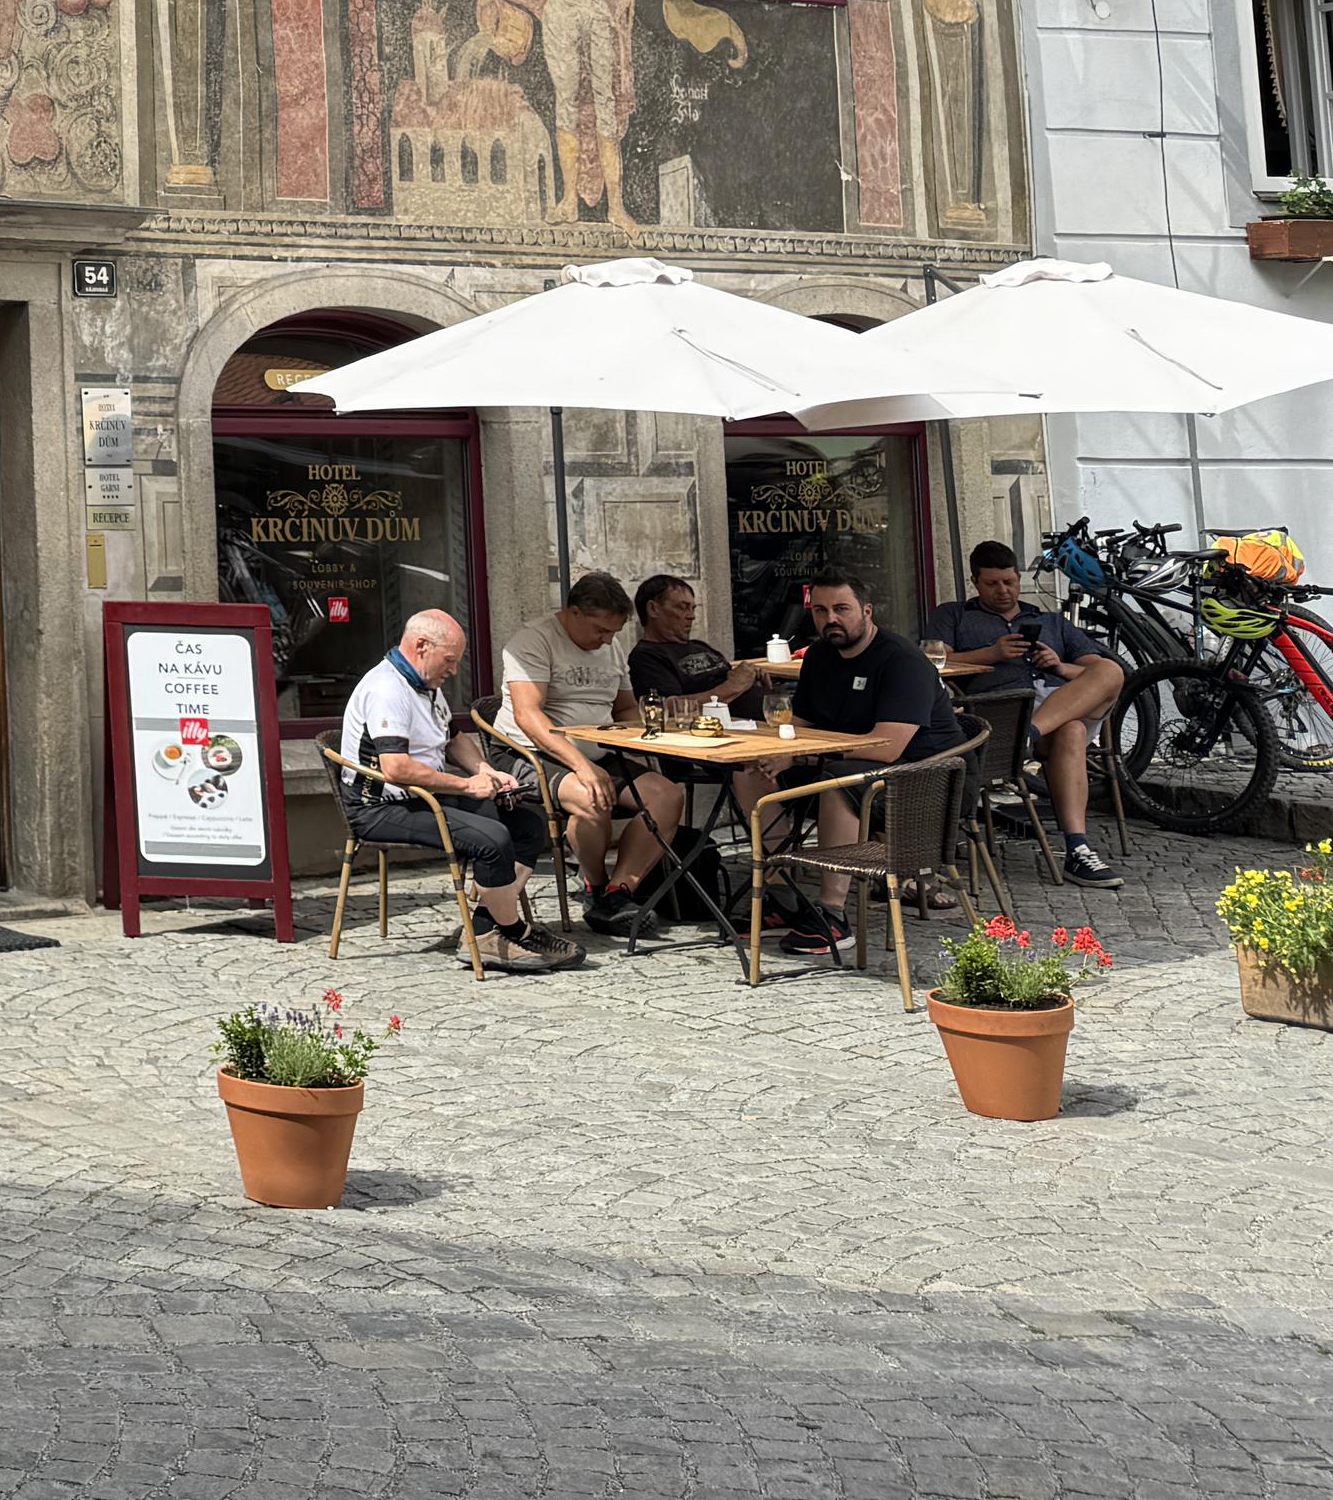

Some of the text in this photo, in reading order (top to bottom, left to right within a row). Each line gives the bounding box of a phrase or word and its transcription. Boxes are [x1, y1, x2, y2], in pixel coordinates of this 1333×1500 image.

[85, 266, 109, 285] 54
[308, 464, 361, 480] HOTEL
[93, 512, 130, 523] RECEPCE
[366, 509, 421, 542] DŮM
[311, 563, 344, 573] LOBBY
[293, 579, 377, 590] SOUVENIR SHOP
[329, 600, 348, 619] illy
[175, 640, 202, 655] ČAS
[158, 661, 222, 675] NA KÁVU
[164, 683, 219, 695] COFFEE
[176, 703, 210, 715] TIME
[182, 721, 208, 743] illy
